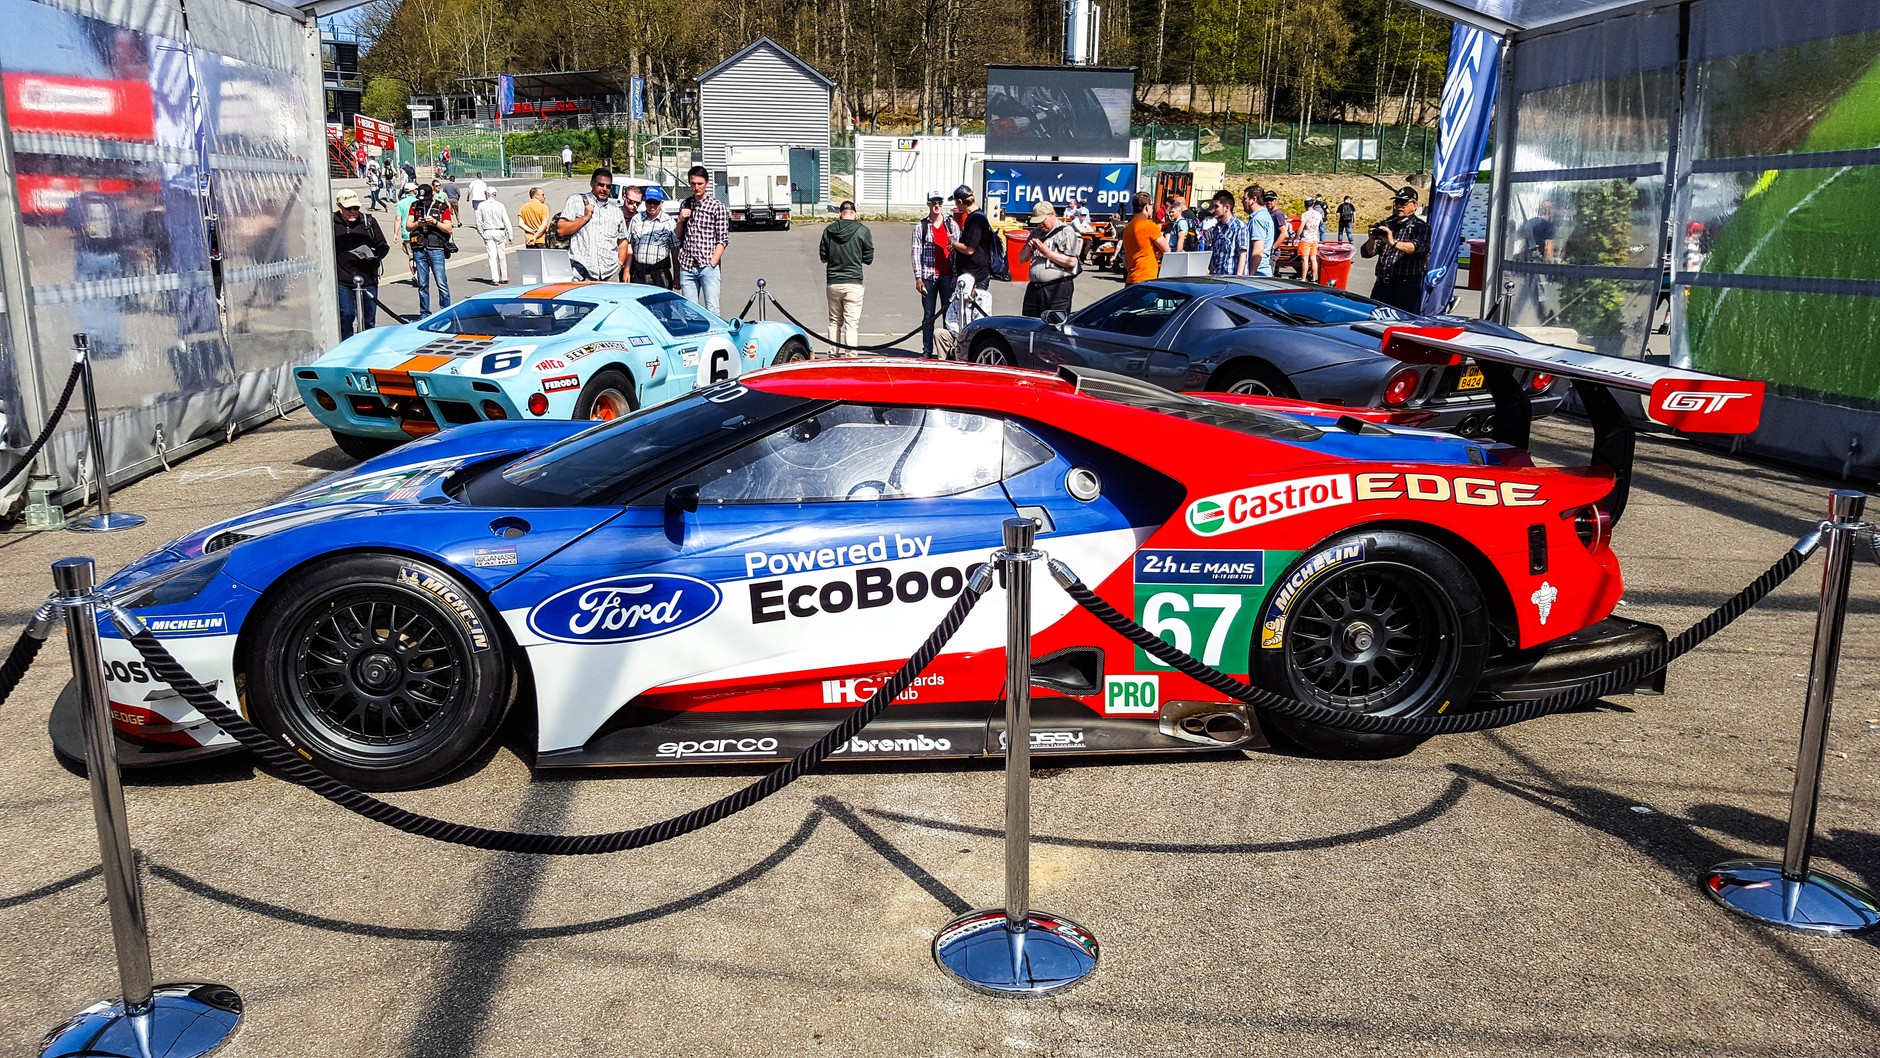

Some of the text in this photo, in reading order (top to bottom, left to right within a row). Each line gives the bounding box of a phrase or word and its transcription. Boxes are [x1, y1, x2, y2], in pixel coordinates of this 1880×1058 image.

[1015, 185, 1044, 202] FIA
[1097, 190, 1130, 207] app
[481, 350, 522, 375] 6
[535, 360, 565, 372] TRICO
[709, 349, 729, 384] 6
[544, 378, 578, 390] FERODO
[1461, 377, 1482, 388] 8424
[1661, 391, 1752, 414] GT
[1228, 472, 1550, 524] Castrol EDGE
[744, 533, 932, 578] Powered by
[1179, 563, 1202, 573] LE
[1203, 563, 1255, 574] MANS
[1274, 546, 1360, 612] MICHELIN
[421, 577, 488, 648] MICHELIN
[569, 583, 683, 635] Ford
[151, 617, 223, 630] MICHELIN
[1142, 591, 1242, 667] 67
[822, 677, 878, 703] IHG
[1108, 681, 1156, 708] PRO
[114, 711, 145, 726] EDGE
[657, 737, 779, 758] sparco
[851, 734, 952, 752] brembo
